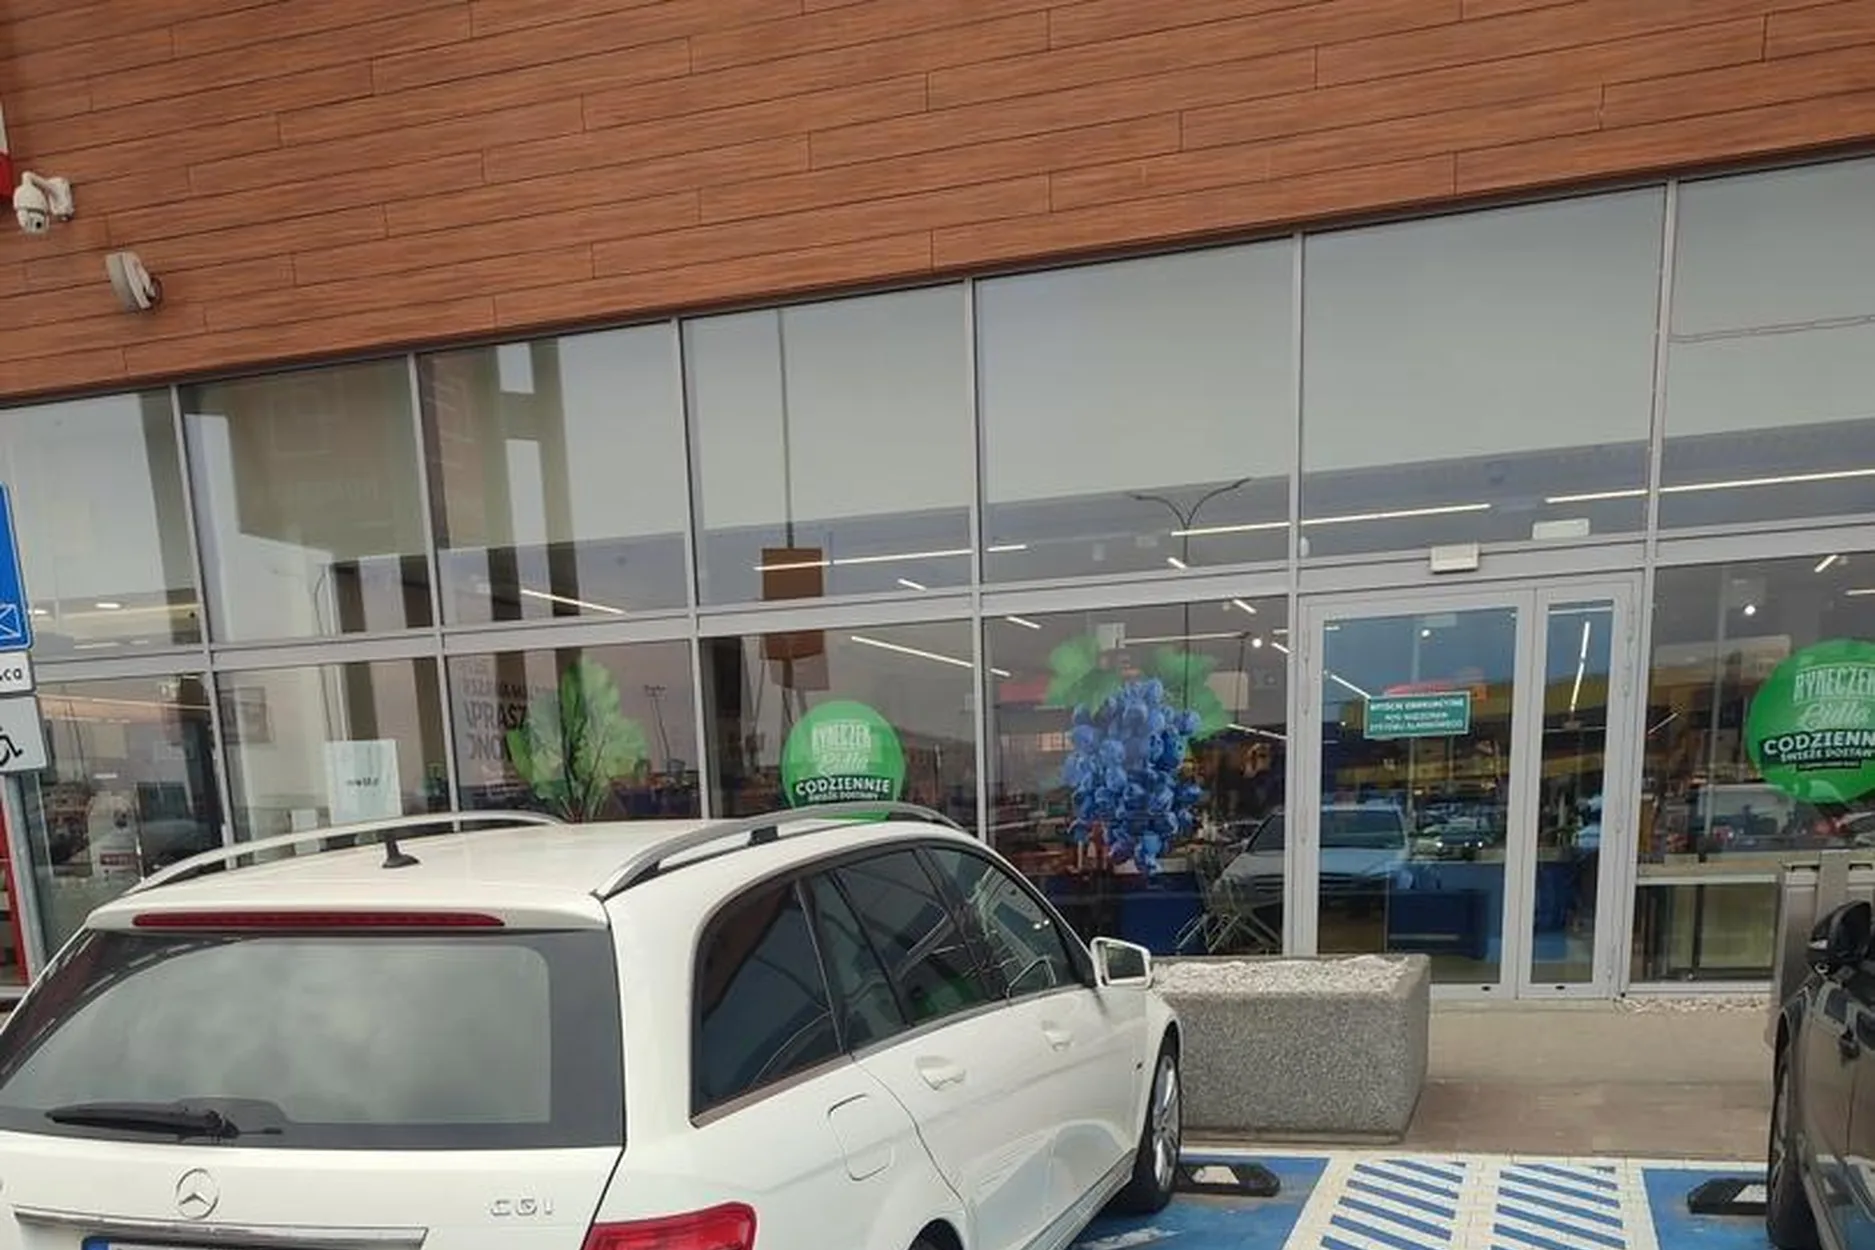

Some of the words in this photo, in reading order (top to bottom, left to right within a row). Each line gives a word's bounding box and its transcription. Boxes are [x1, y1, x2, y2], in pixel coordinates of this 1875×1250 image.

[0, 667, 22, 681] ca
[795, 776, 891, 796] CODZIENNIE
[489, 1198, 553, 1217] CGI
